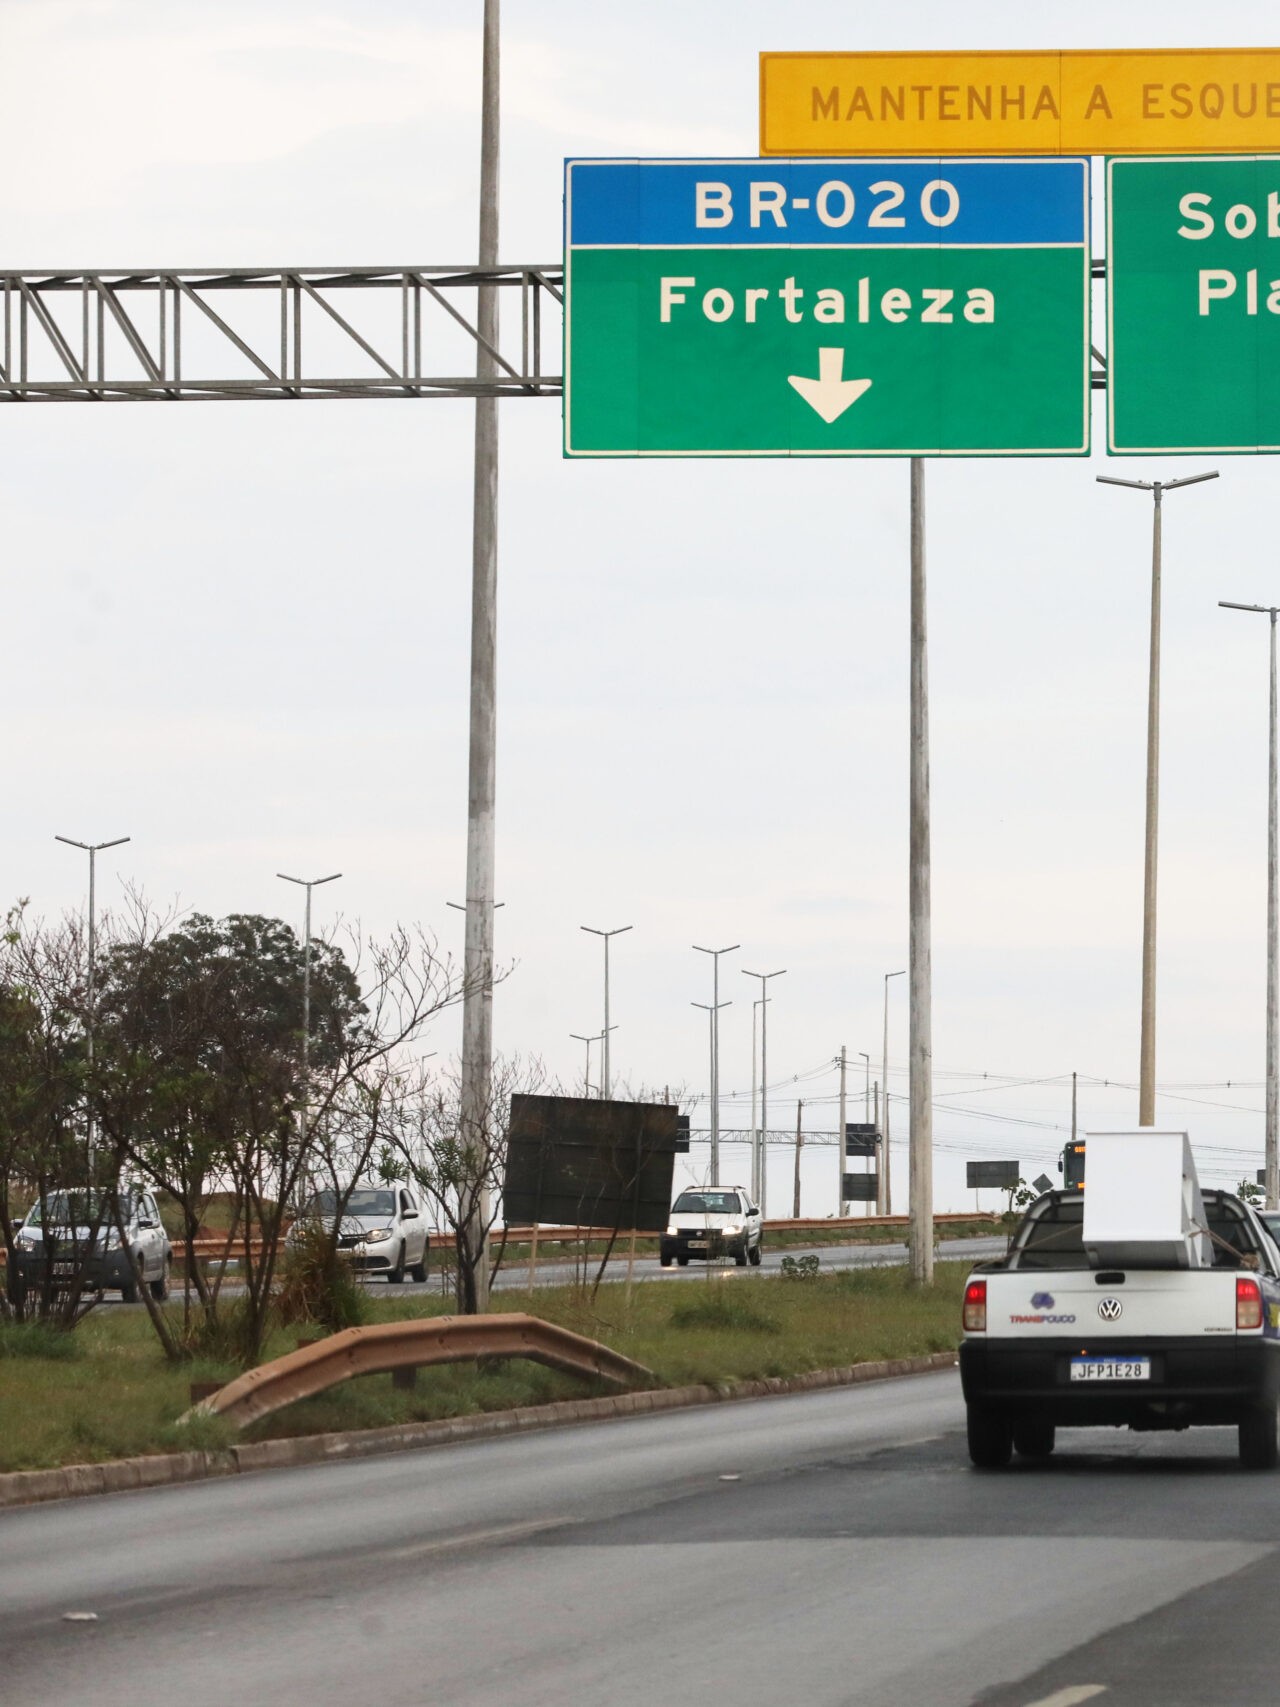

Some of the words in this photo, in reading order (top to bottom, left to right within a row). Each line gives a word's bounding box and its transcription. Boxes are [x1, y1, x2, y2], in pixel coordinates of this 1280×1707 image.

[811, 84, 1060, 121] MANTENHA
[1084, 84, 1113, 120] A
[695, 179, 960, 228] BR-020
[659, 276, 996, 324] Fortaleza
[1078, 1363, 1142, 1378] JFP1E28
